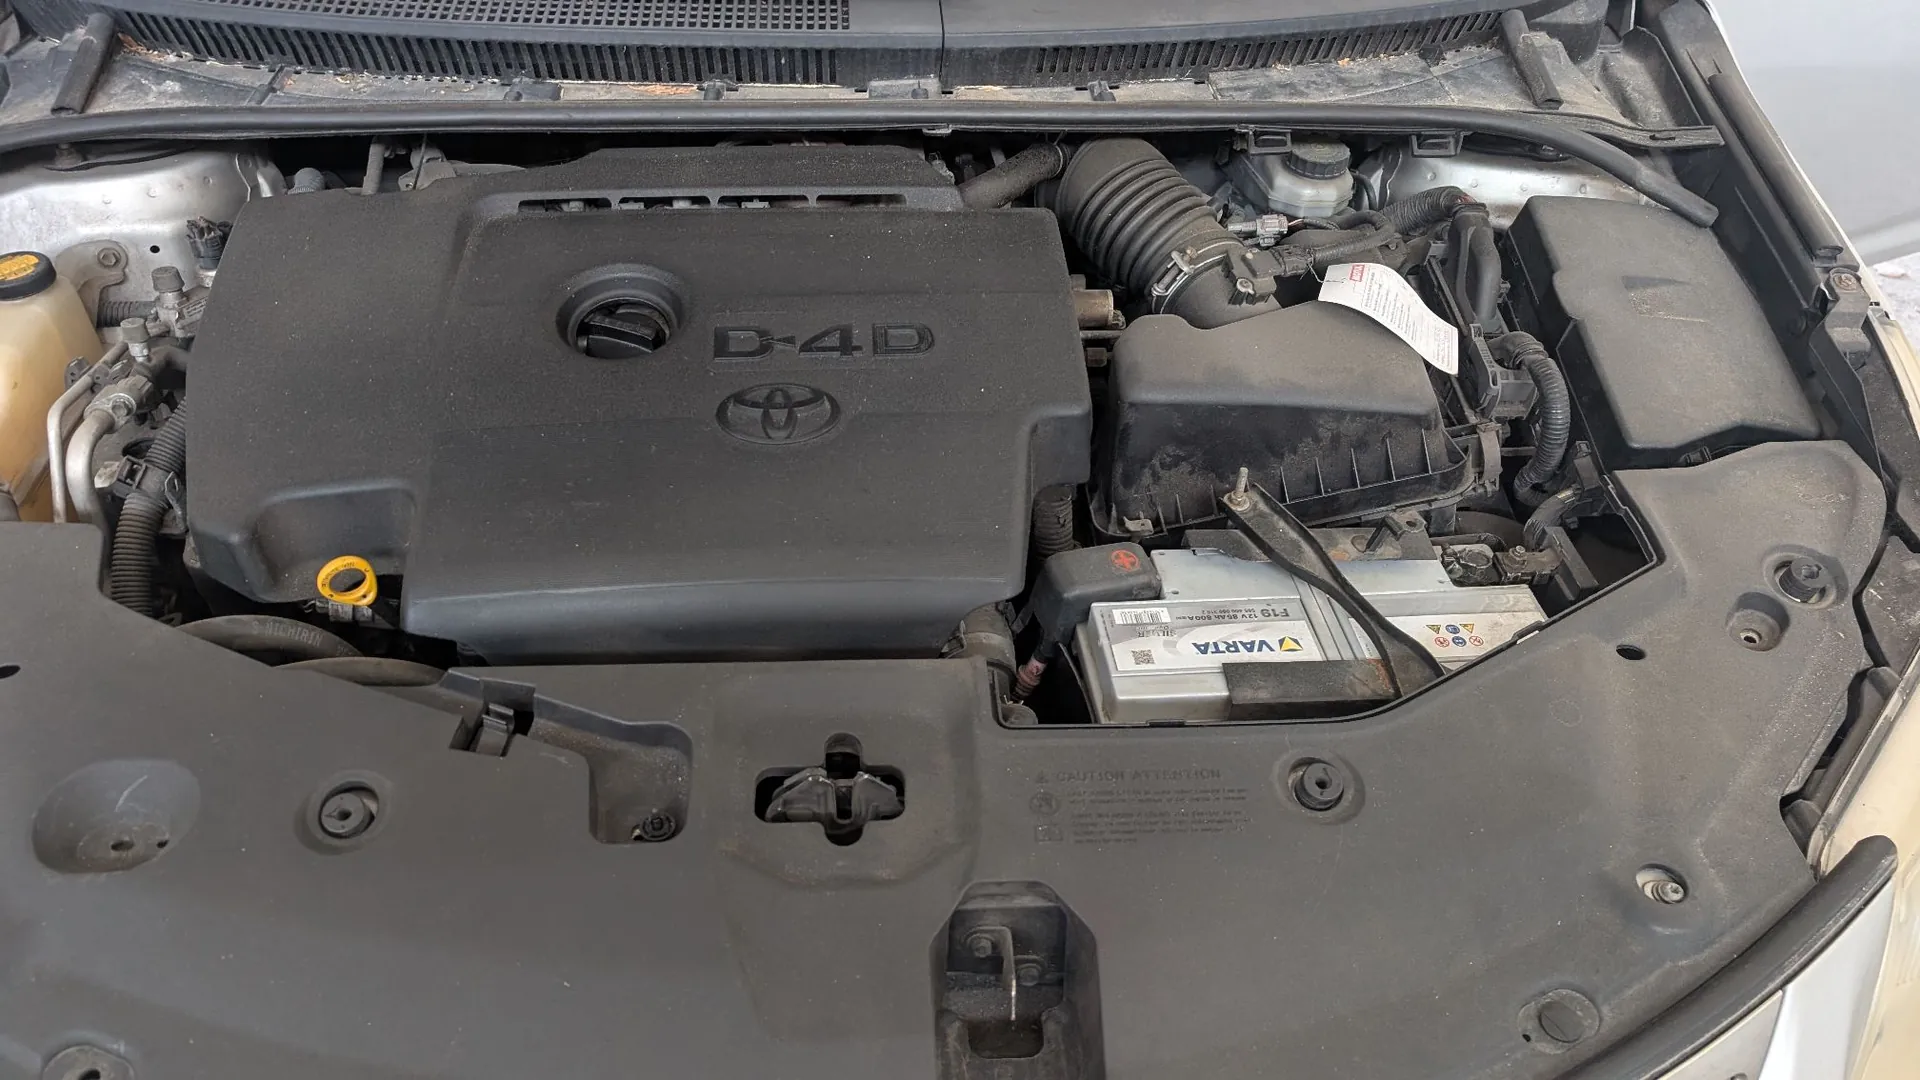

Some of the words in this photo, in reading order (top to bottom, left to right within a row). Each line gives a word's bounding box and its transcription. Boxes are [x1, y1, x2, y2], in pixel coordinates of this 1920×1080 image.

[1260, 608, 1290, 618] F19
[1191, 640, 1275, 655] VARTA
[1055, 769, 1125, 782] CAUTION
